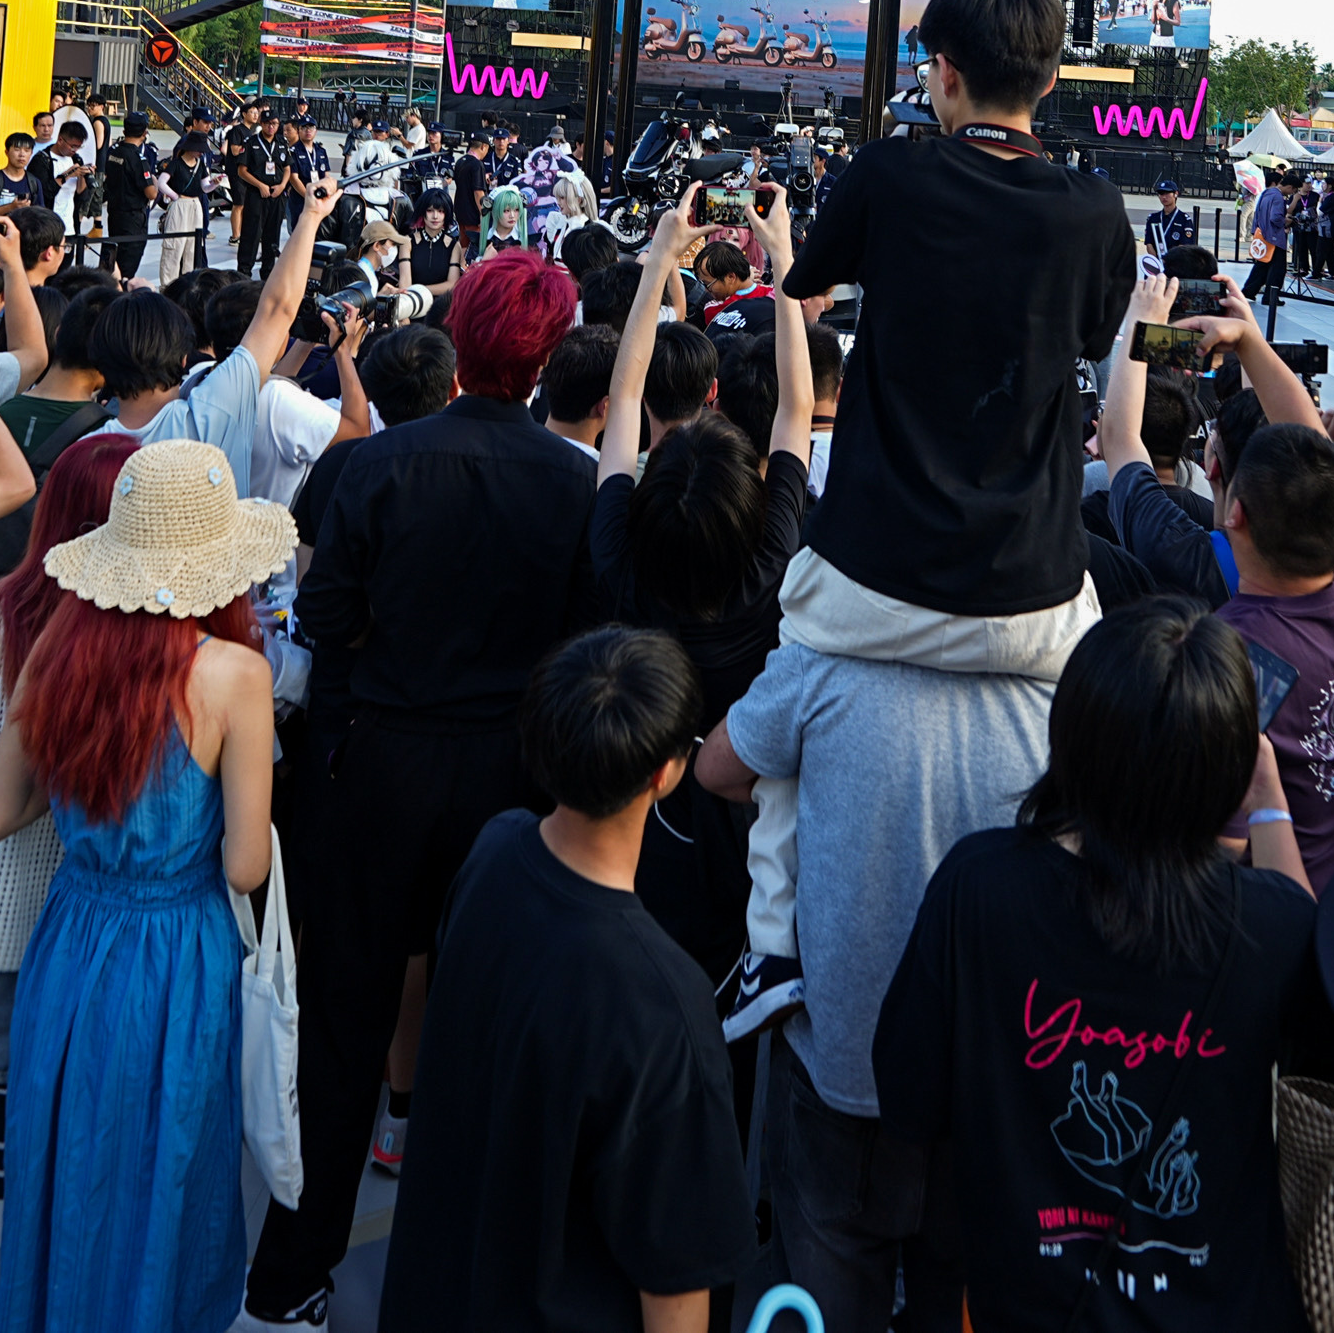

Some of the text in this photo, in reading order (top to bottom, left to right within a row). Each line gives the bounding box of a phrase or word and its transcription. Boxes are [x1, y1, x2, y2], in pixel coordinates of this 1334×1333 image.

[280, 3, 313, 16] ZENLESS
[965, 126, 1007, 141] Canon
[1024, 977, 1227, 1070] Yoasobi
